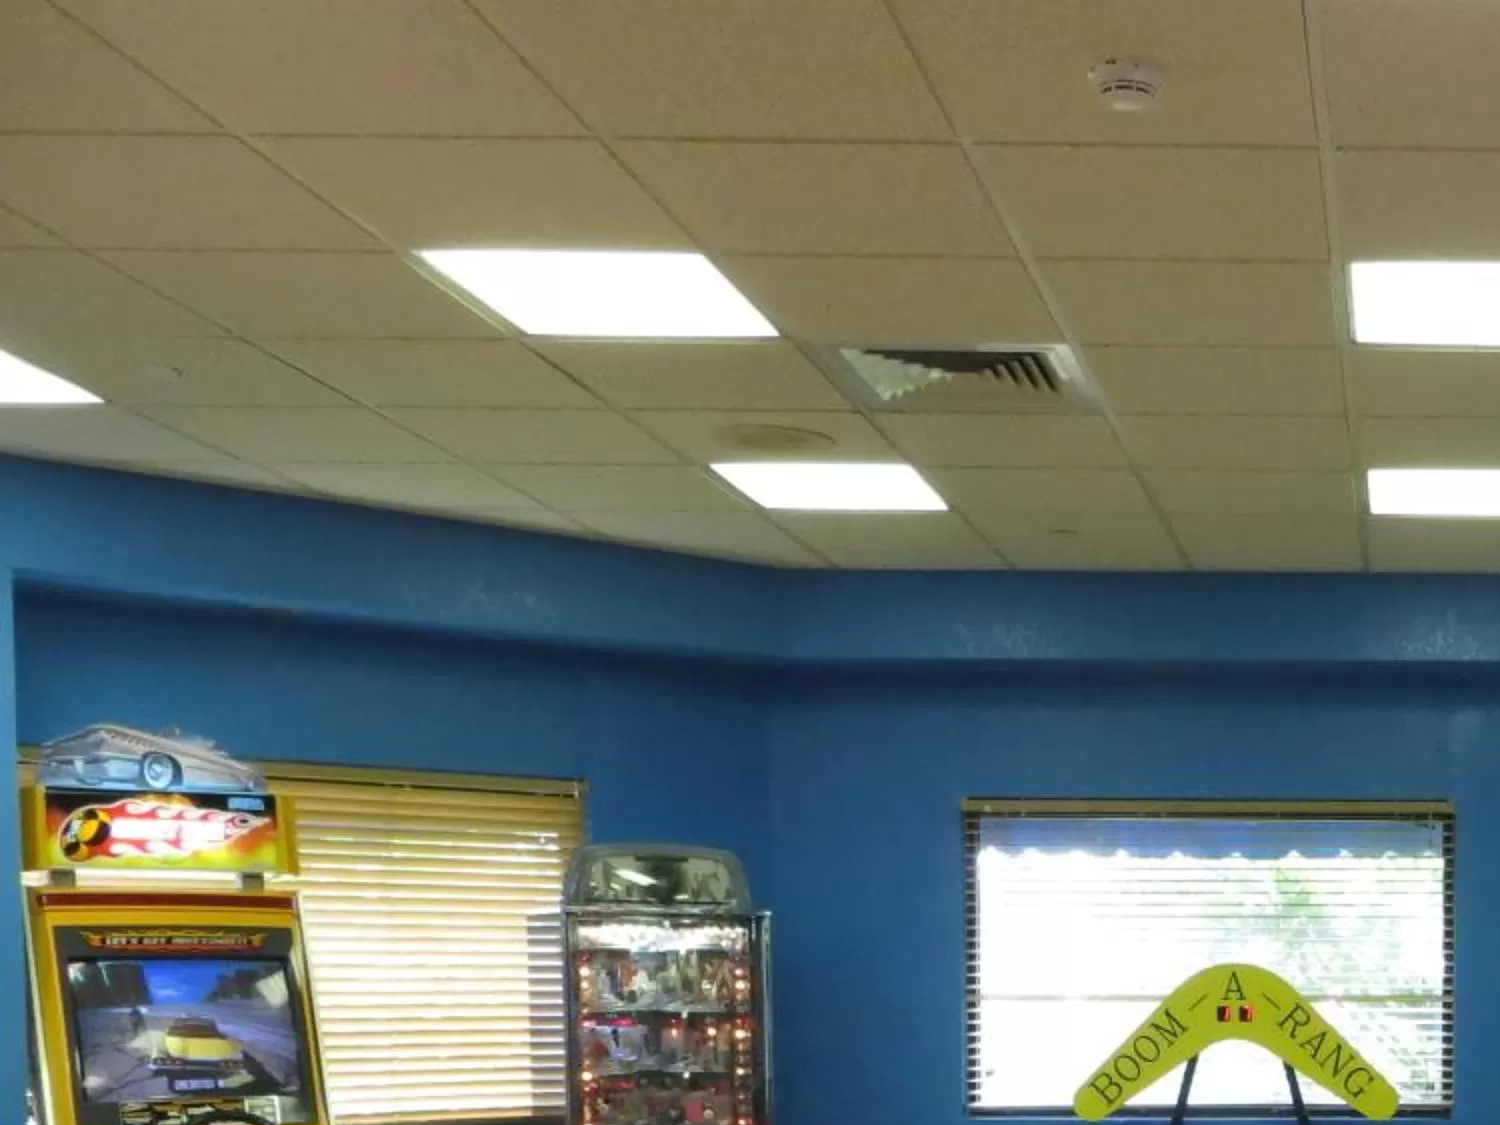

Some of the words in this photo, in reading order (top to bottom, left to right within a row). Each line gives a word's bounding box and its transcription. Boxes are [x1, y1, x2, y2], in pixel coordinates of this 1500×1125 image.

[1088, 1008, 1190, 1108] BOOM
[1220, 971, 1248, 1001] A
[1276, 1002, 1376, 1099] RANG
